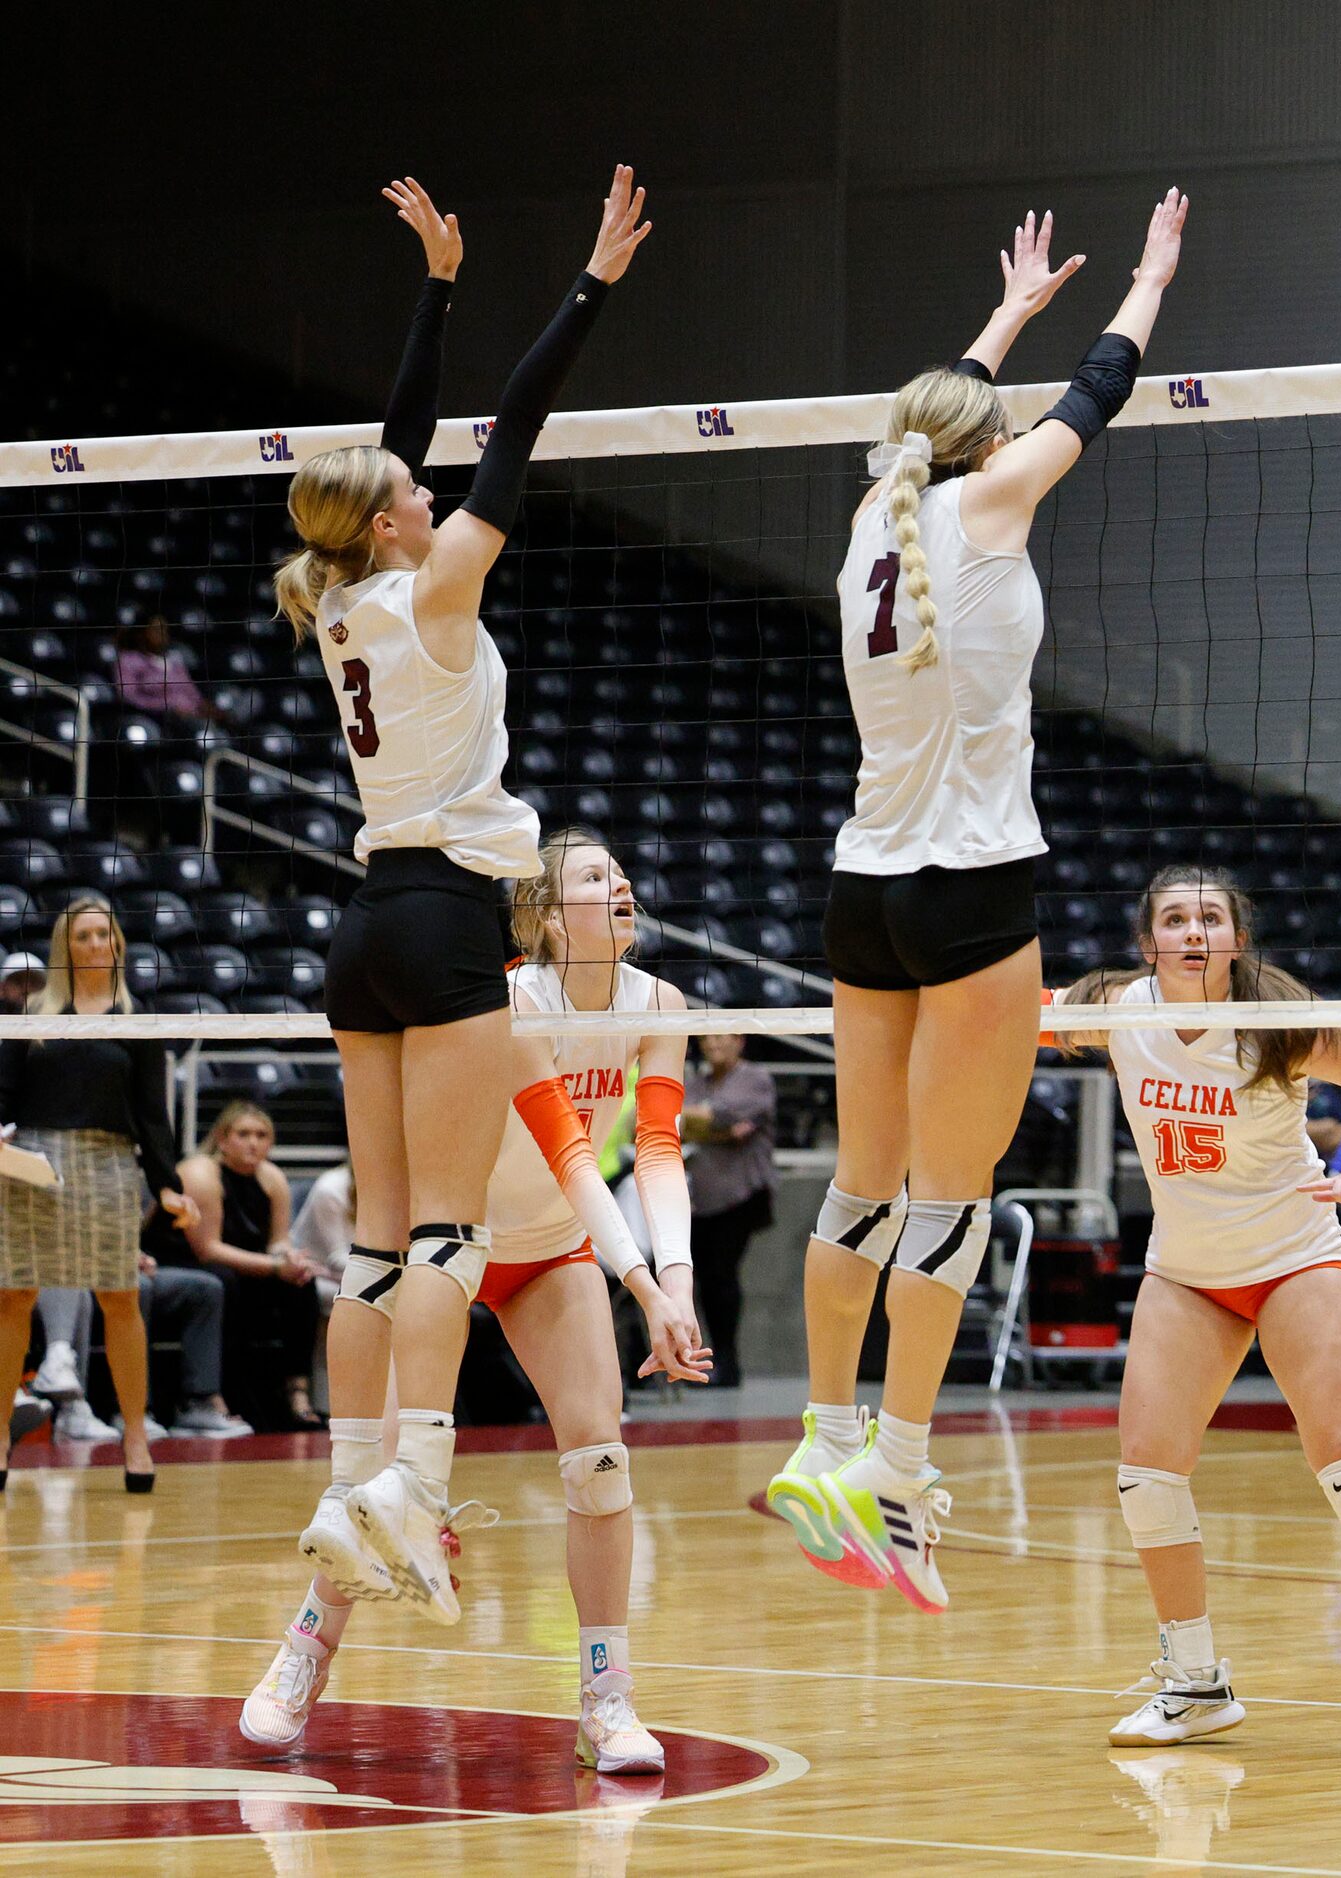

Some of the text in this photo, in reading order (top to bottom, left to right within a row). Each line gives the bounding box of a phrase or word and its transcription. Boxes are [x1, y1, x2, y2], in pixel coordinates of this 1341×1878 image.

[866, 552, 901, 658] 7
[341, 657, 380, 758] 3
[560, 1068, 624, 1100] ELINA
[1139, 1078, 1237, 1116] CELINA
[1152, 1118, 1226, 1176] 15
[594, 1463, 618, 1473] adidas
